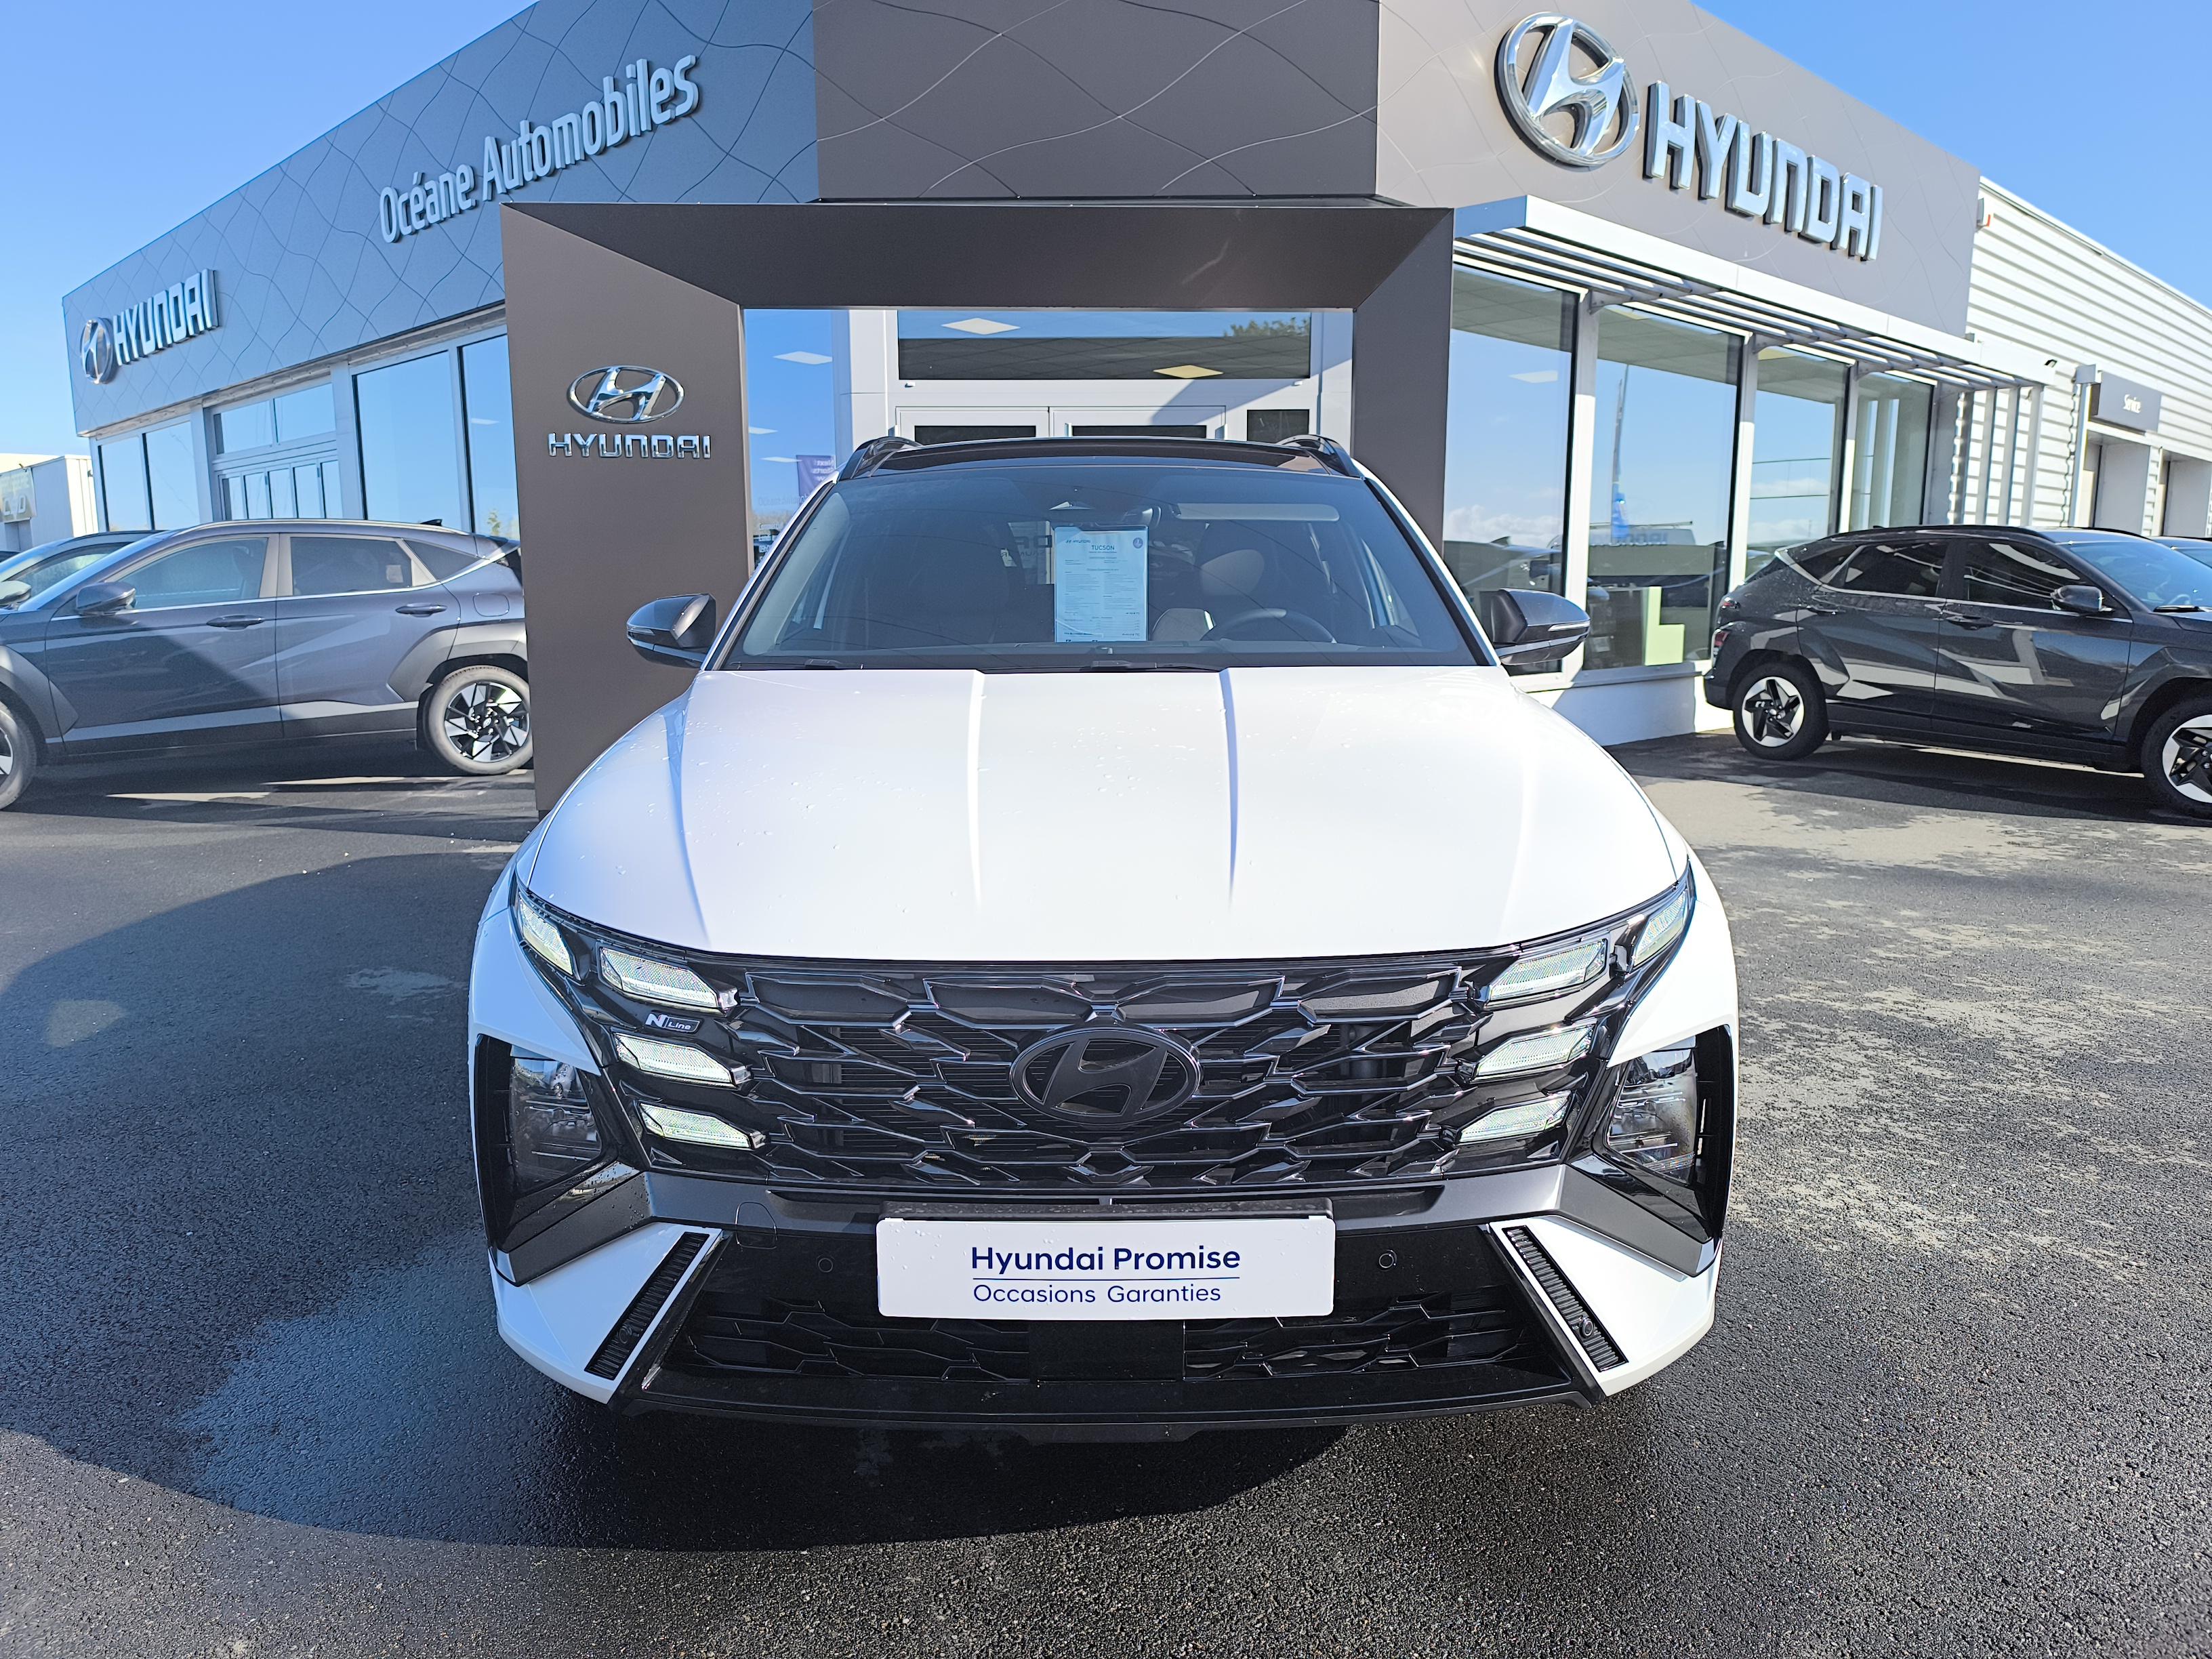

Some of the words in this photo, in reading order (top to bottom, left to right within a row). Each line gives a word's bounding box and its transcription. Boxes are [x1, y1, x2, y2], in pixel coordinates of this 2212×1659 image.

[380, 164, 476, 243] Océane
[483, 55, 699, 201] Automobiles
[1644, 81, 1883, 261] HYUNDAI
[112, 268, 216, 366] HYUNDAI
[548, 433, 712, 459] HYUNDAI
[668, 1021, 691, 1030] Line
[972, 1246, 1103, 1274] Hyundai
[1114, 1246, 1240, 1270] Promise
[974, 1284, 1096, 1303] Occasions
[1107, 1284, 1221, 1303] Garanties
